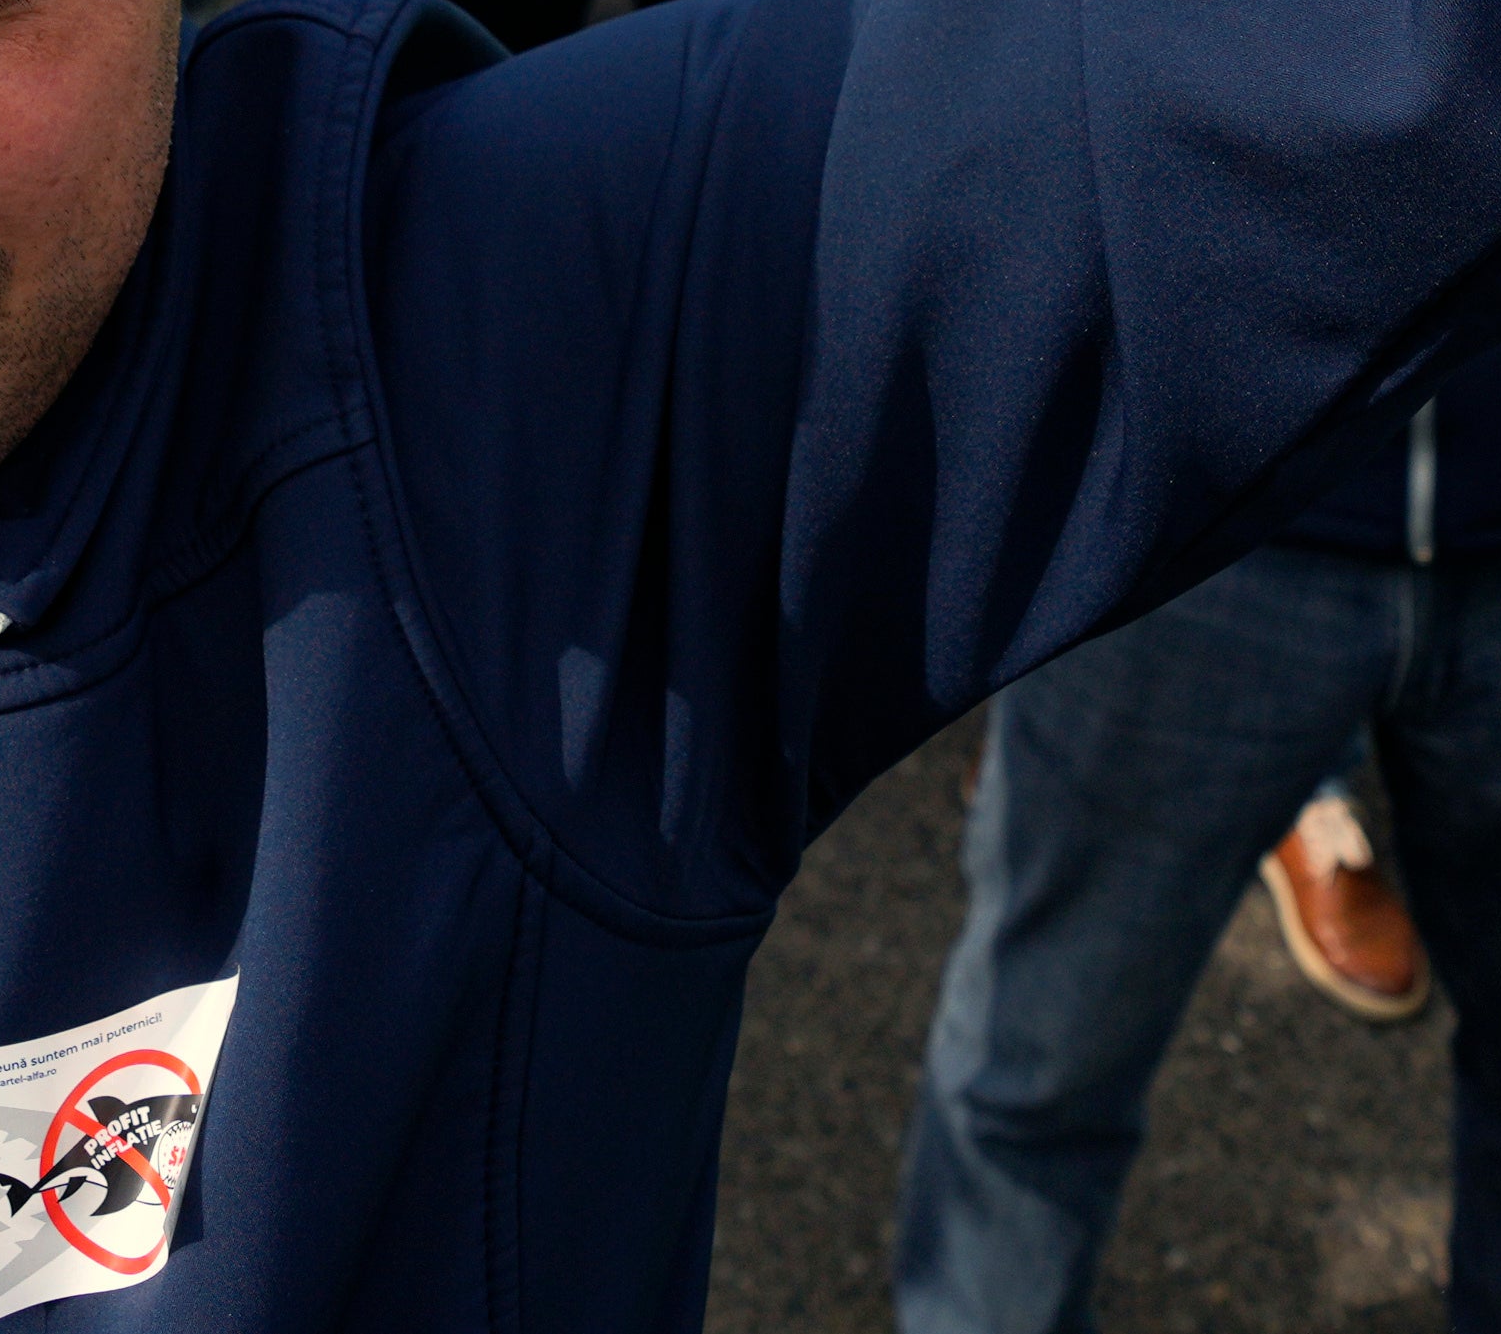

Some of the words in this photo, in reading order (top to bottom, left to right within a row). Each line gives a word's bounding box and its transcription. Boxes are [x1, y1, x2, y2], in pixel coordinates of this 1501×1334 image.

[30, 1045, 79, 1067] suntem
[81, 1033, 104, 1051] mai
[106, 1012, 164, 1043] puternici!
[83, 1105, 151, 1157] PROFIT
[90, 1119, 164, 1171] INFLAȚIE
